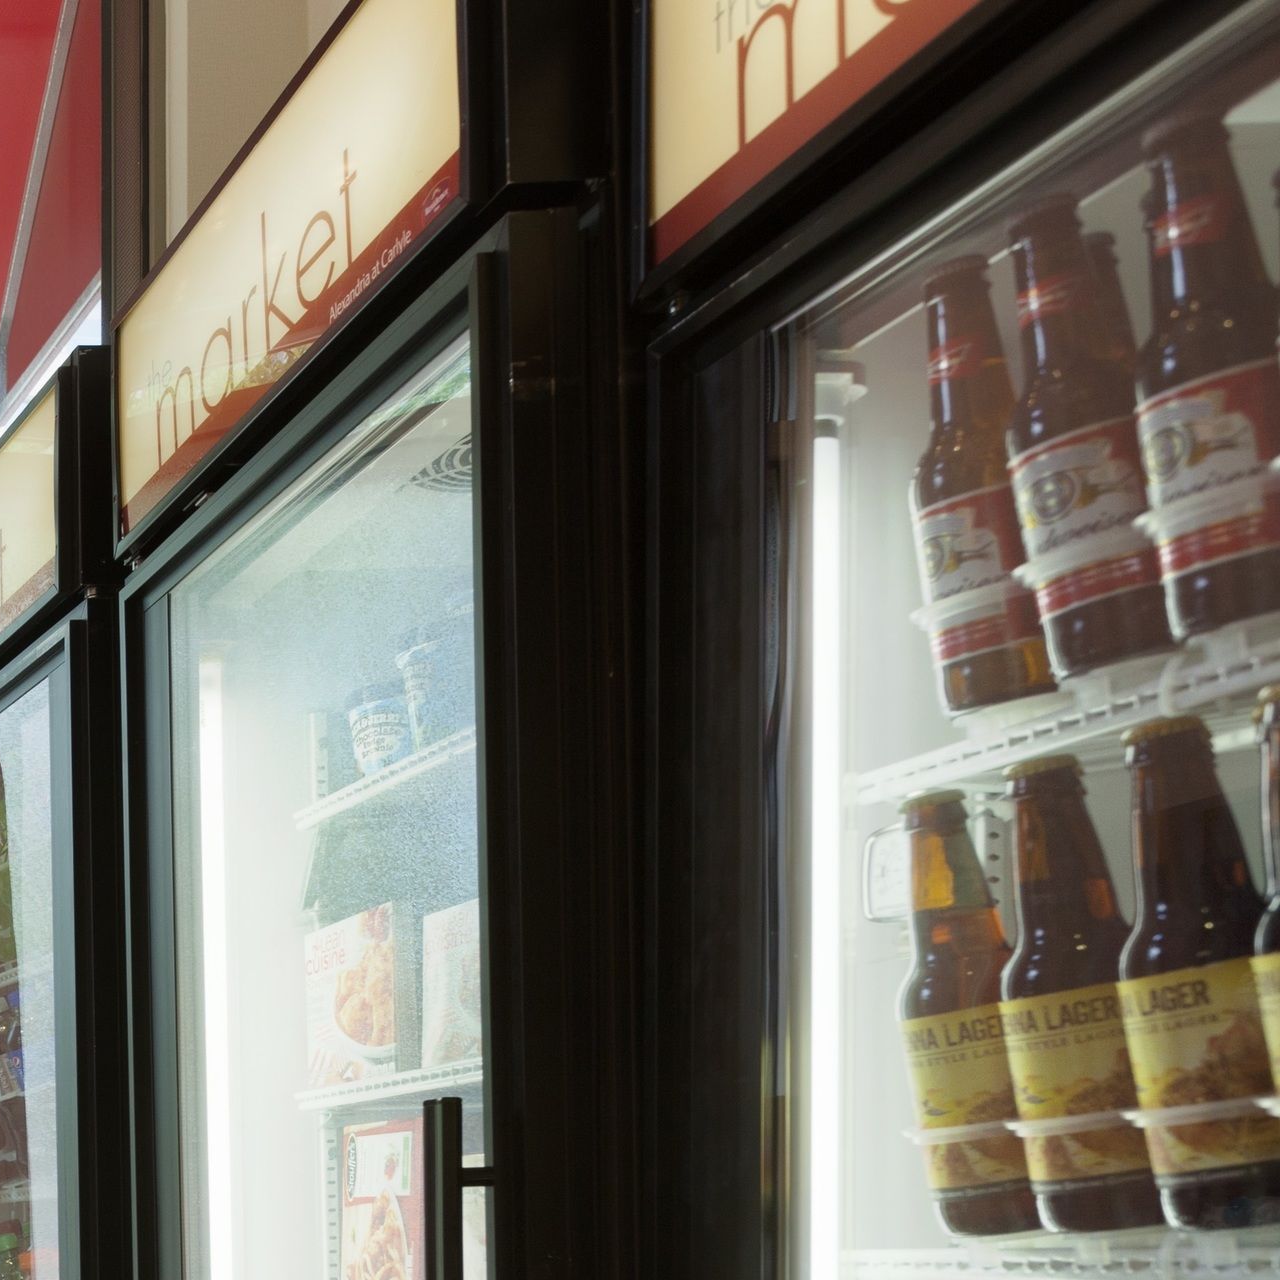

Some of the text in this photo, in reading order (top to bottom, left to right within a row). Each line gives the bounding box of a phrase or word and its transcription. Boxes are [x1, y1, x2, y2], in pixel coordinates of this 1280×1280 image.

[154, 149, 359, 469] market
[329, 230, 412, 325] Alexandria at Carlyle
[1043, 995, 1118, 1032] LAGER
[1141, 979, 1212, 1017] LAGER
